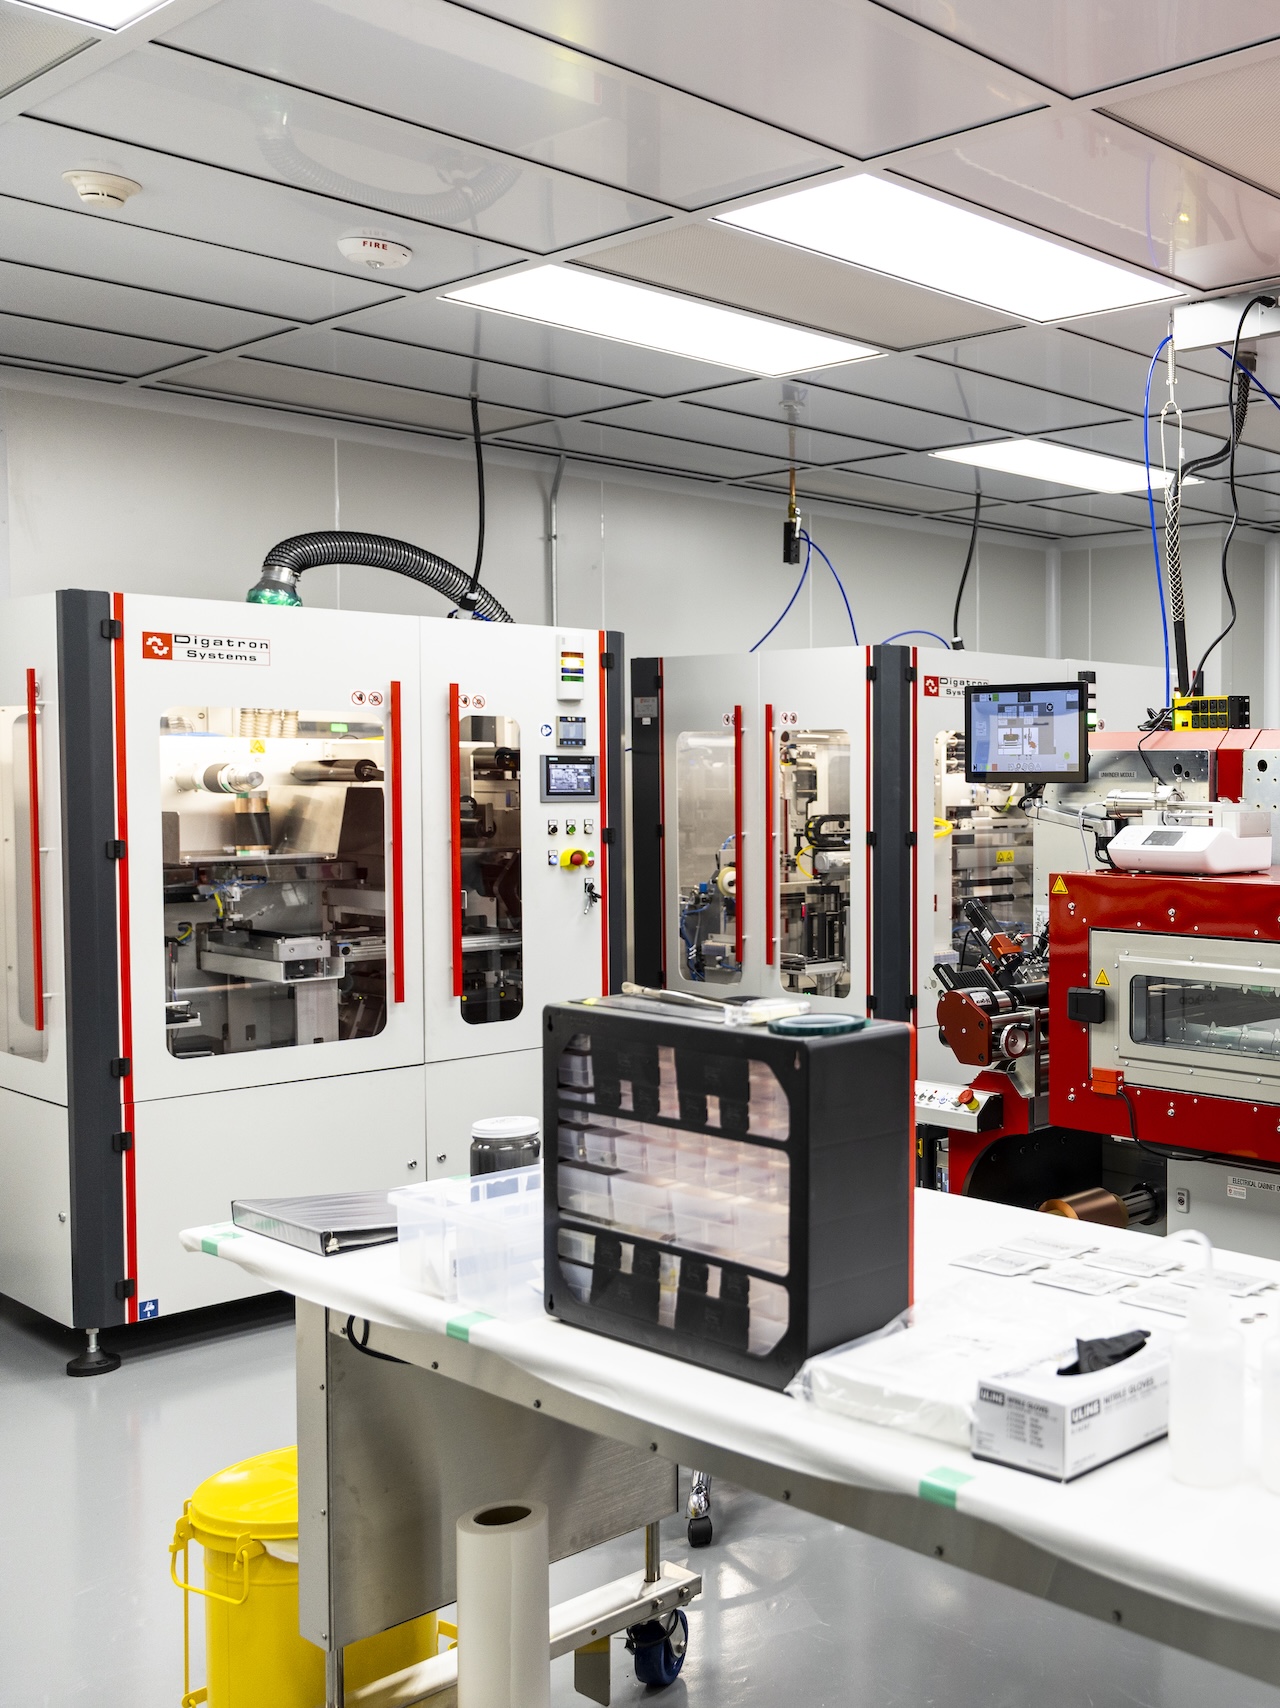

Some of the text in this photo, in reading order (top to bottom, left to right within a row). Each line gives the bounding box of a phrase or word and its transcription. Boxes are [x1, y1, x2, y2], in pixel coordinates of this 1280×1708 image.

[362, 240, 388, 251] FIRE
[174, 634, 269, 649] Digatron
[186, 649, 257, 662] Systems
[945, 688, 966, 697] Syst
[1232, 1177, 1257, 1188] ELECTRICAL
[1257, 1182, 1276, 1191] CABINET
[1072, 1399, 1100, 1423] ULINE
[1104, 1390, 1127, 1405] NITRILE
[1127, 1377, 1154, 1394] GLOVES
